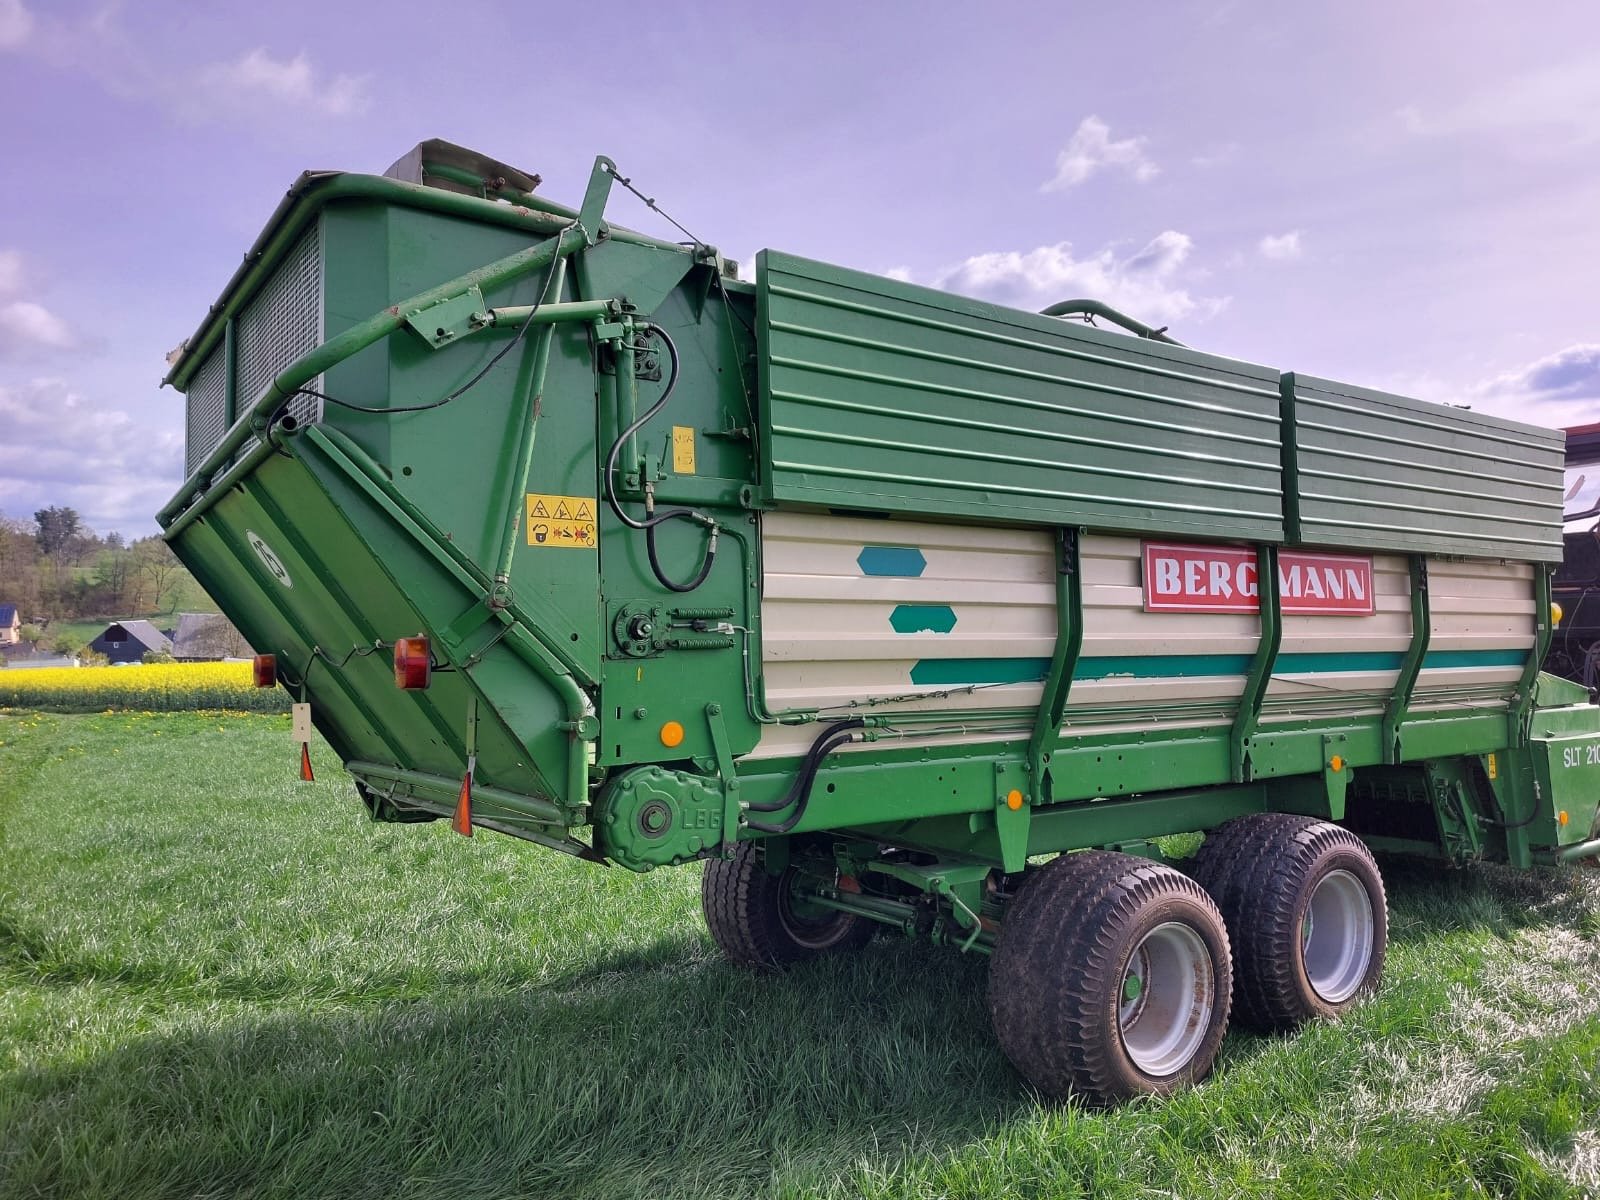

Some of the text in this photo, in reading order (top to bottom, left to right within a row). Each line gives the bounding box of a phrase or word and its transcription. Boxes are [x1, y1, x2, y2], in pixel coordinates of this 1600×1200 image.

[252, 540, 286, 579] 25
[1155, 558, 1365, 601] BERGMANN
[1563, 746, 1582, 768] SLT
